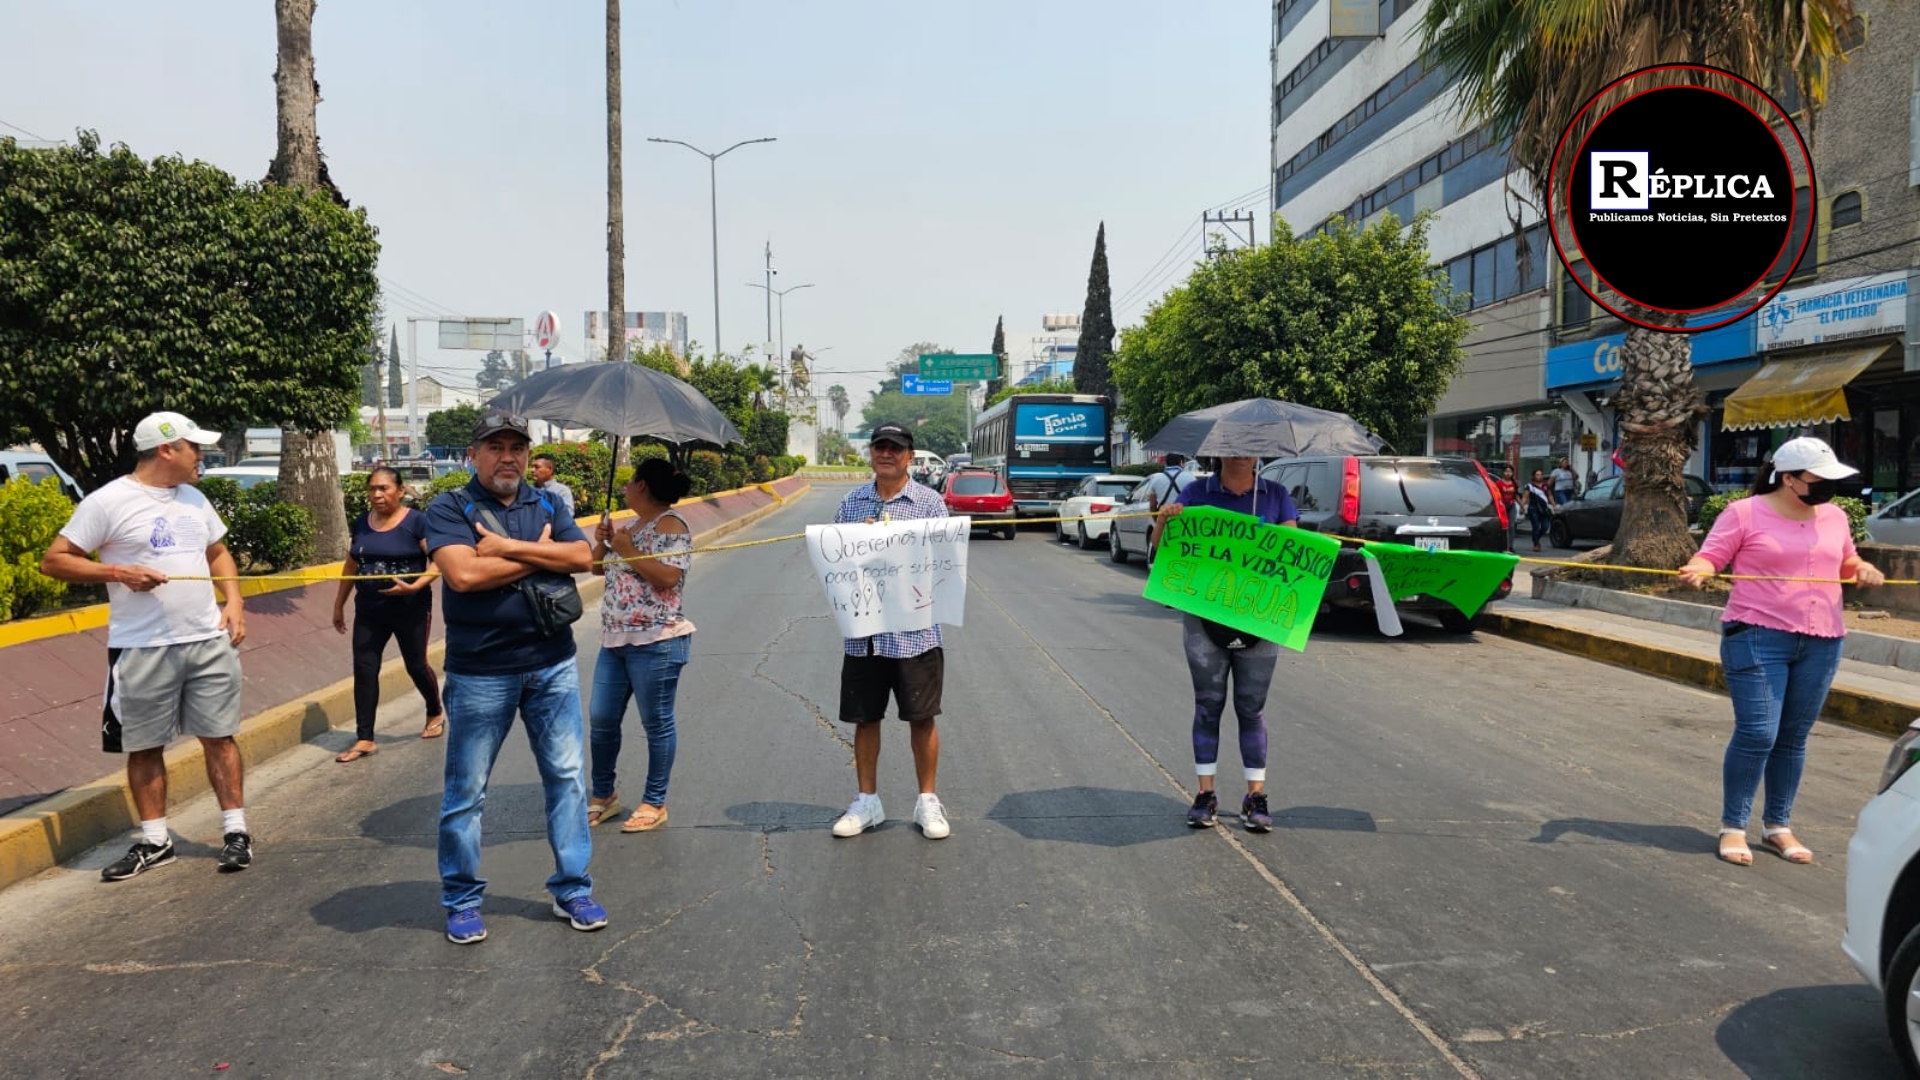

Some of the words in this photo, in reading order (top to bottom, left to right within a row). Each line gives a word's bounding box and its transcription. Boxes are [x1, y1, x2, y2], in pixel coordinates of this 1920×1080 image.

[1797, 296, 1843, 314] FARMACIA
[1844, 281, 1908, 305] VETERINARIA
[940, 358, 992, 366] AEROPUERTO
[1593, 342, 1624, 375] Co
[1035, 412, 1086, 435] Tania
[820, 526, 917, 564] Queremos
[922, 522, 965, 547] AGUA
[1258, 530, 1278, 552] LO
[1276, 539, 1334, 580] BASICO
[825, 571, 858, 596] para
[862, 561, 902, 584] poder
[1180, 541, 1203, 558] DE
[1209, 545, 1232, 563] LA
[1242, 553, 1305, 588] VIDA!
[1161, 560, 1198, 596] EL
[1205, 566, 1300, 629] AGUA
